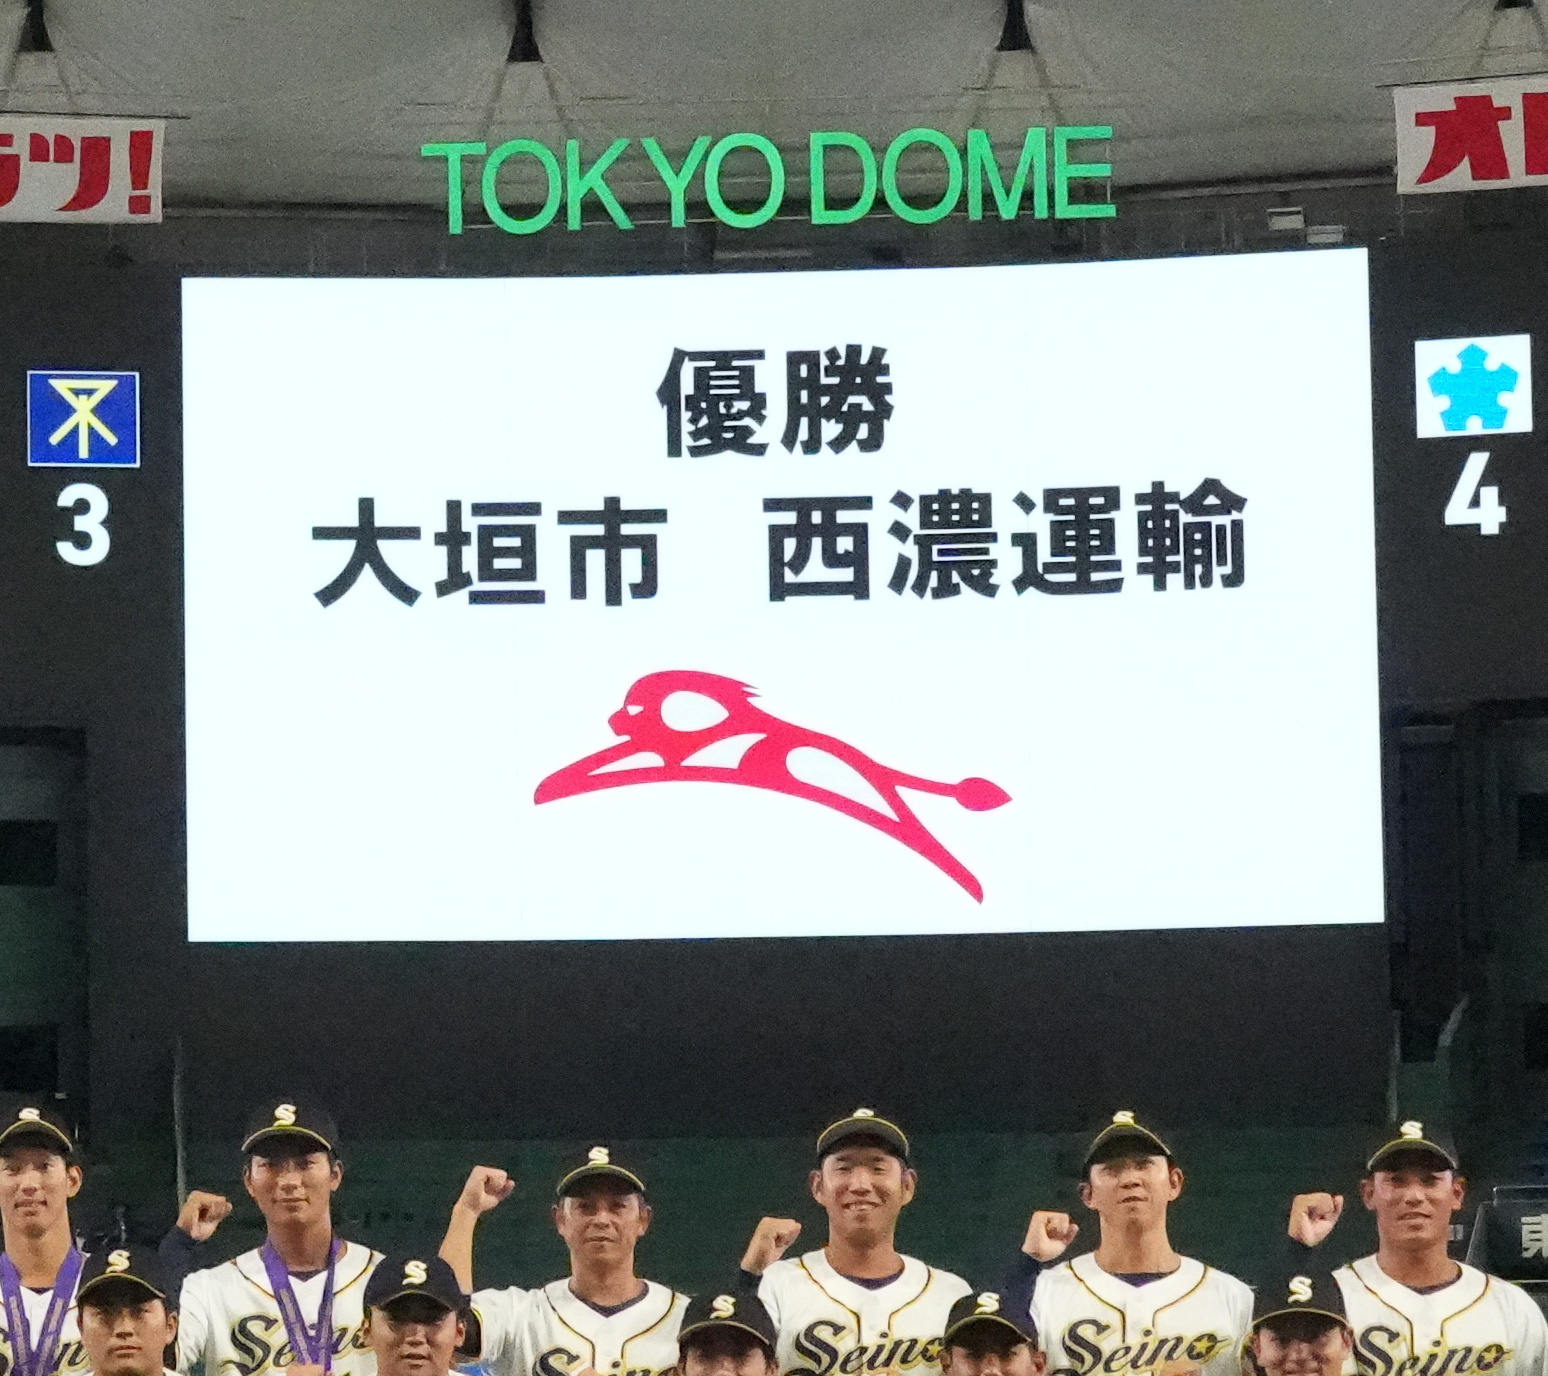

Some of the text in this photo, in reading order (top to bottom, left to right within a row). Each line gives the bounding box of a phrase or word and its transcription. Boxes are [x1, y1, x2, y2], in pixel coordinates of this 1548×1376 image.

[421, 125, 1118, 234] TOKYO DOME
[656, 341, 894, 458] 優勝
[55, 483, 111, 566] 3
[310, 474, 1249, 608] 大垣市 西濃運輸
[1444, 451, 1507, 535] 4
